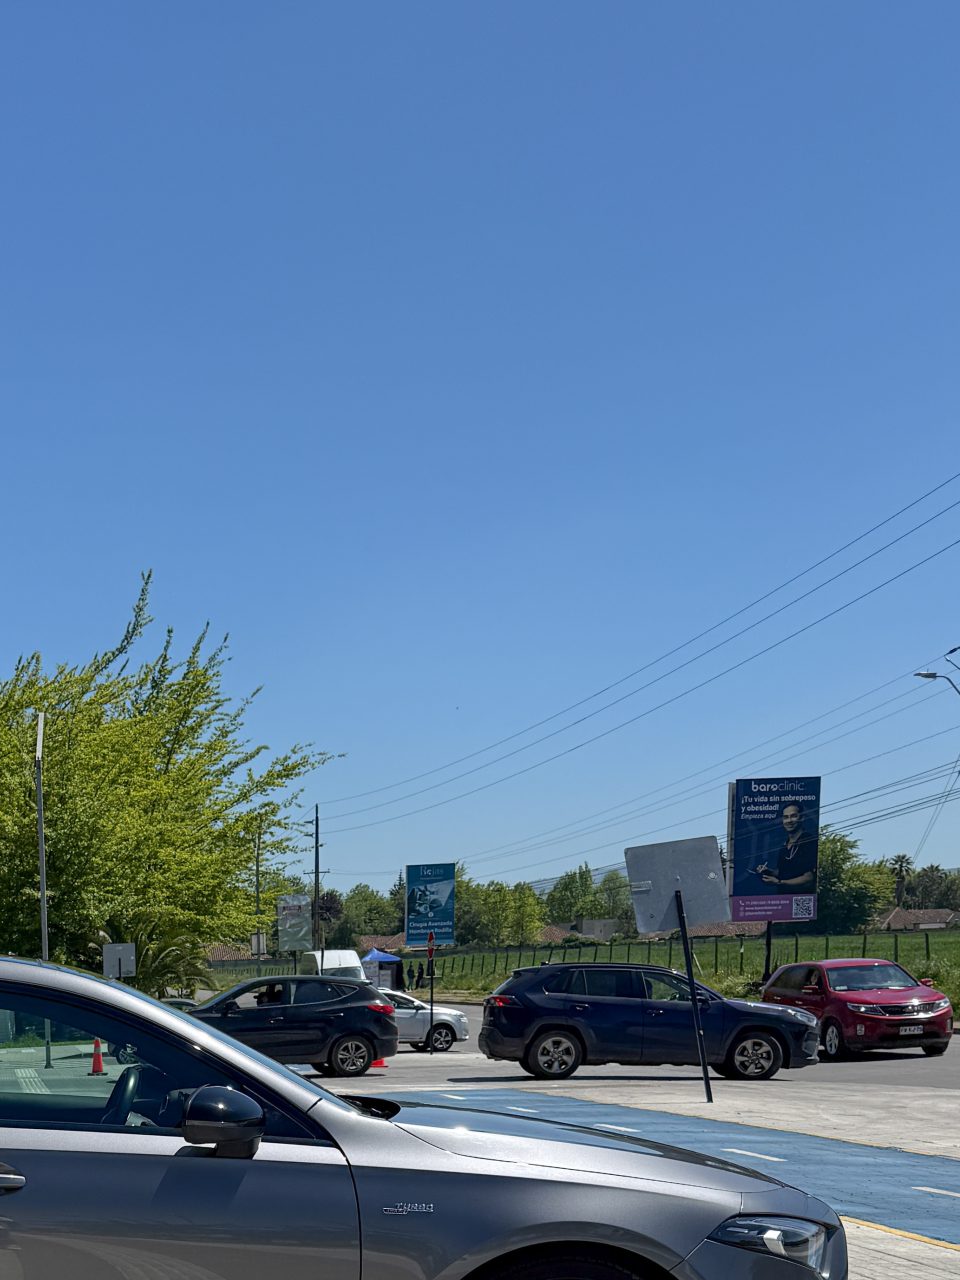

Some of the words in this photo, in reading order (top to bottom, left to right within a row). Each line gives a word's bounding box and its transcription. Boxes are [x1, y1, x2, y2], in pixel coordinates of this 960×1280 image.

[751, 780, 805, 792] baroclinic
[741, 795, 753, 804] ¡Tu
[781, 794, 816, 803] sobrepeso
[395, 1202, 434, 1211] TURBO
